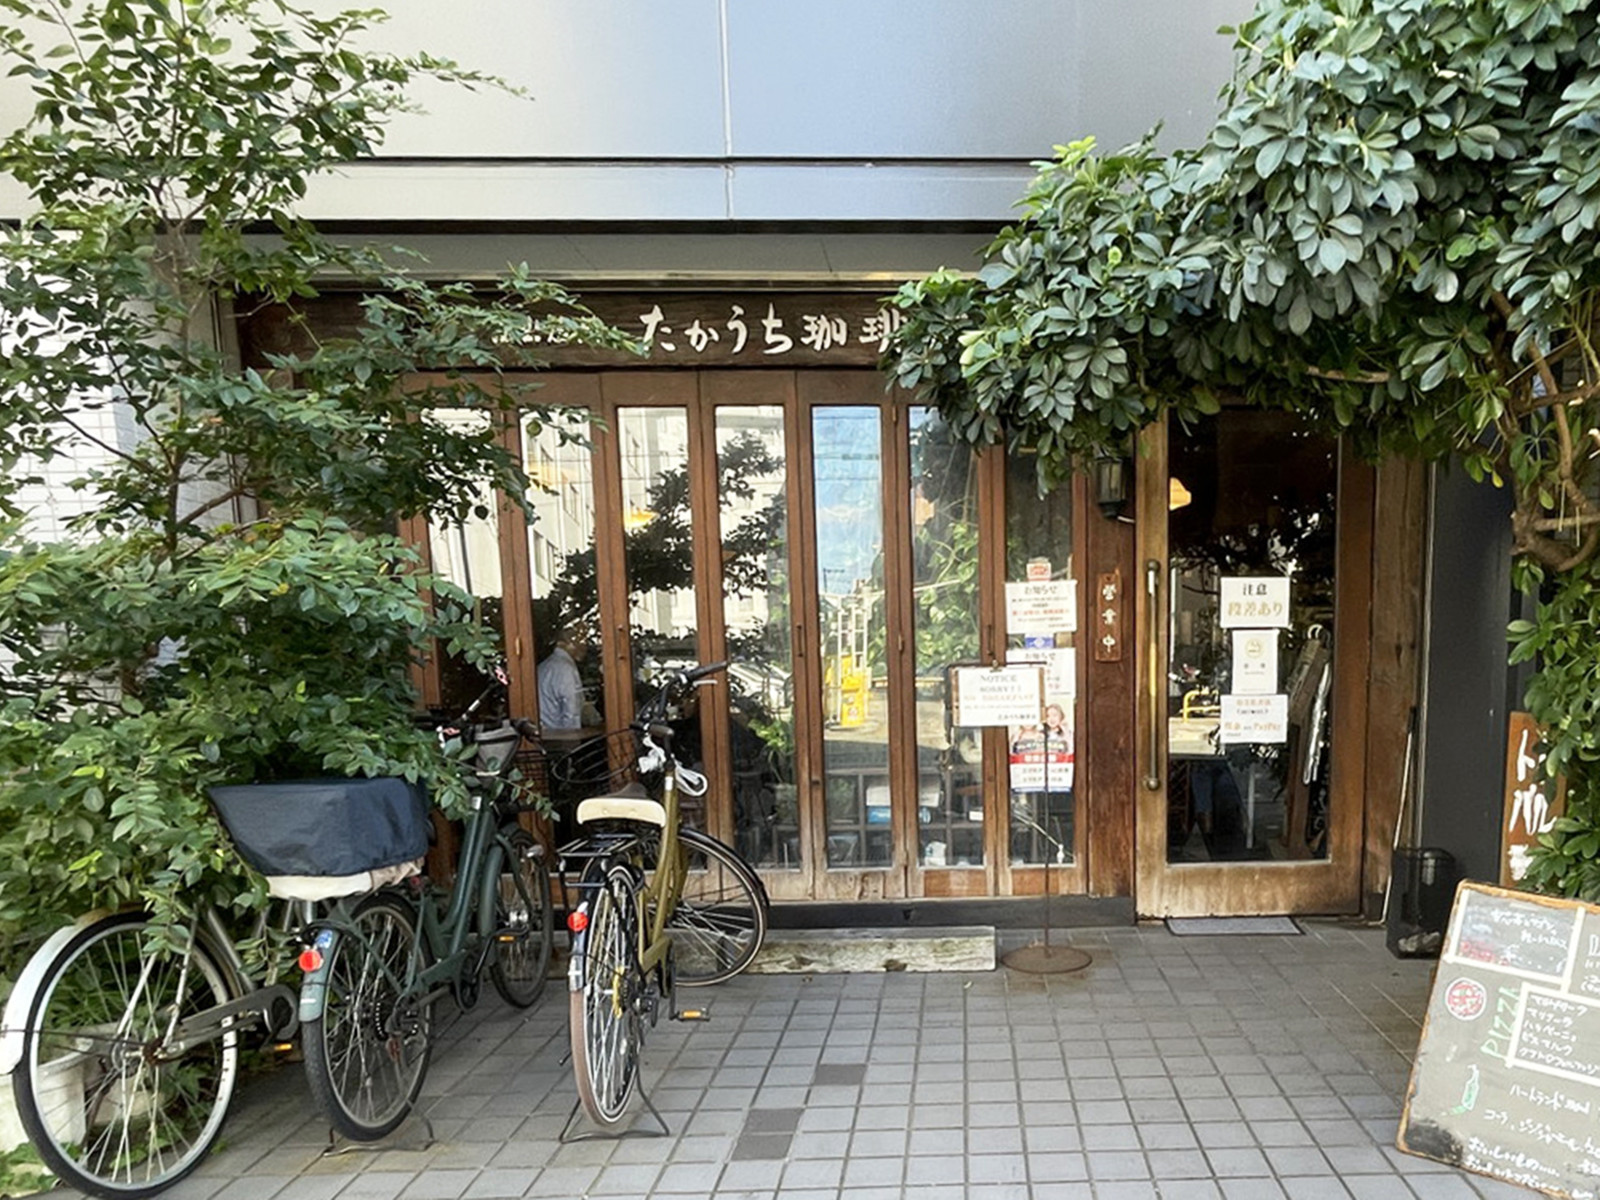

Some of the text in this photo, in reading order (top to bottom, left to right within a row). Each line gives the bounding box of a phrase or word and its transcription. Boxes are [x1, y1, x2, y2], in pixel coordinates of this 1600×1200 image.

[1102, 584, 1117, 653] 営業中
[1228, 602, 1283, 617] 段差あり
